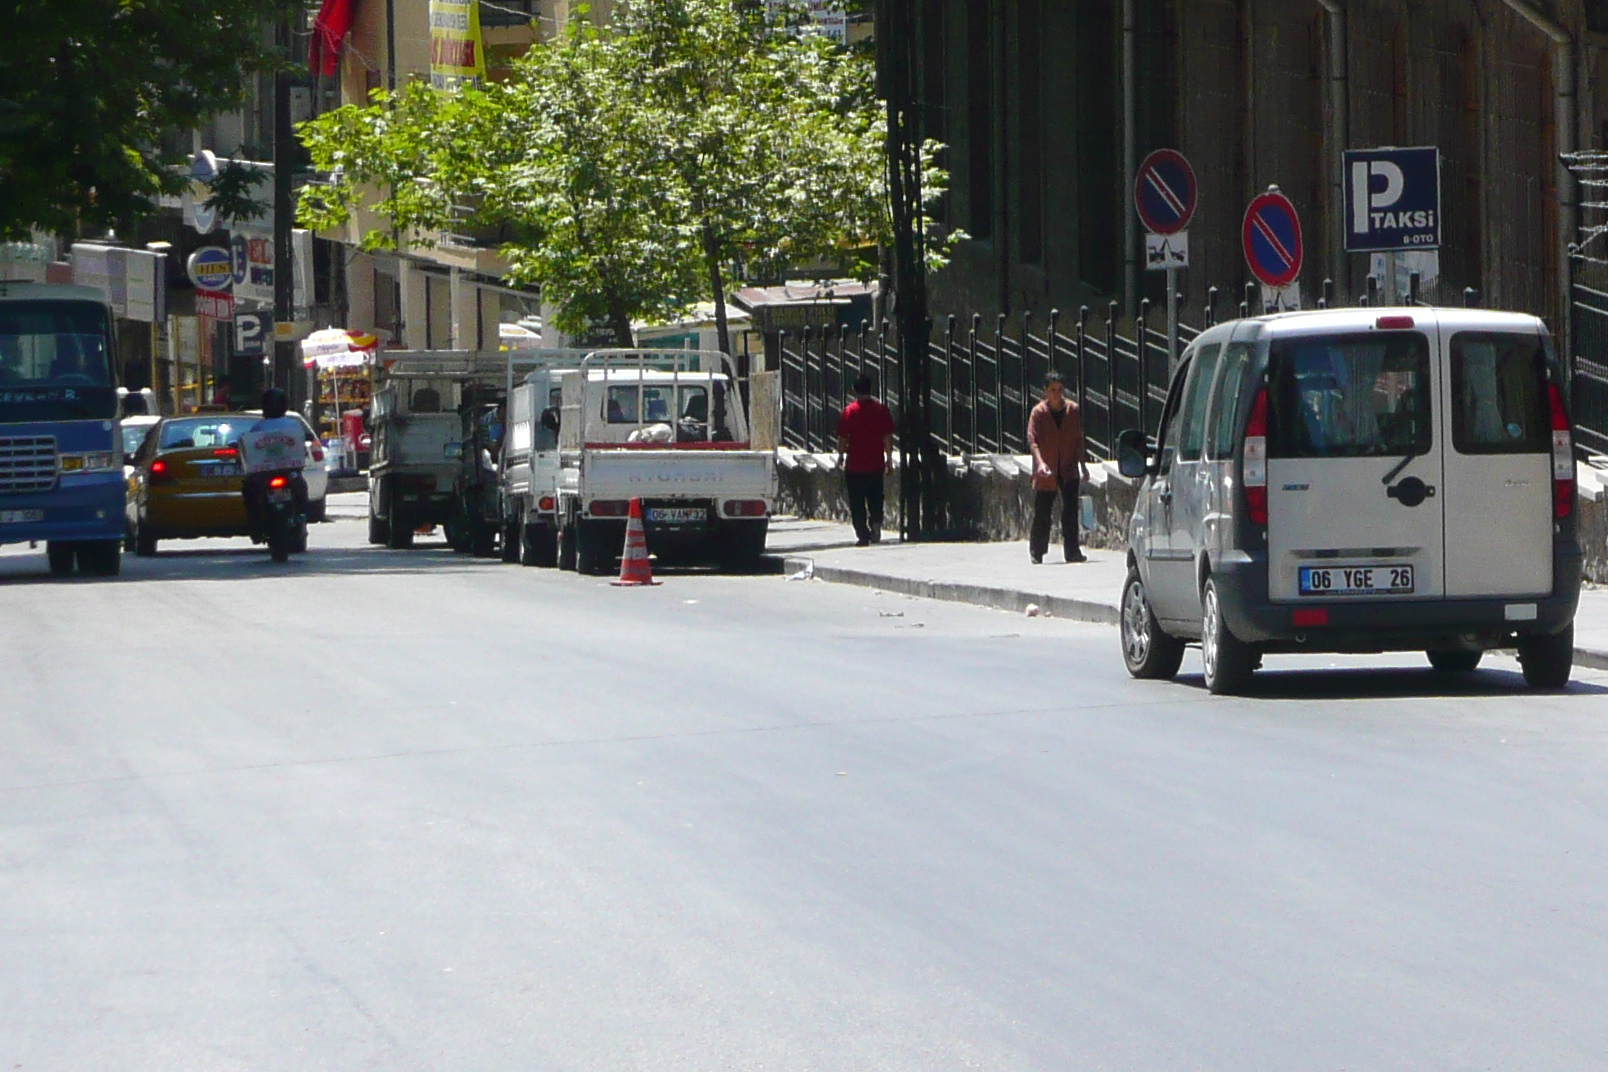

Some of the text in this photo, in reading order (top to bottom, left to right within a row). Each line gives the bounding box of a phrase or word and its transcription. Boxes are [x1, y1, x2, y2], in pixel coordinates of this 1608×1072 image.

[1352, 160, 1405, 234] P
[1311, 569, 1410, 589] 06 YGE 26
